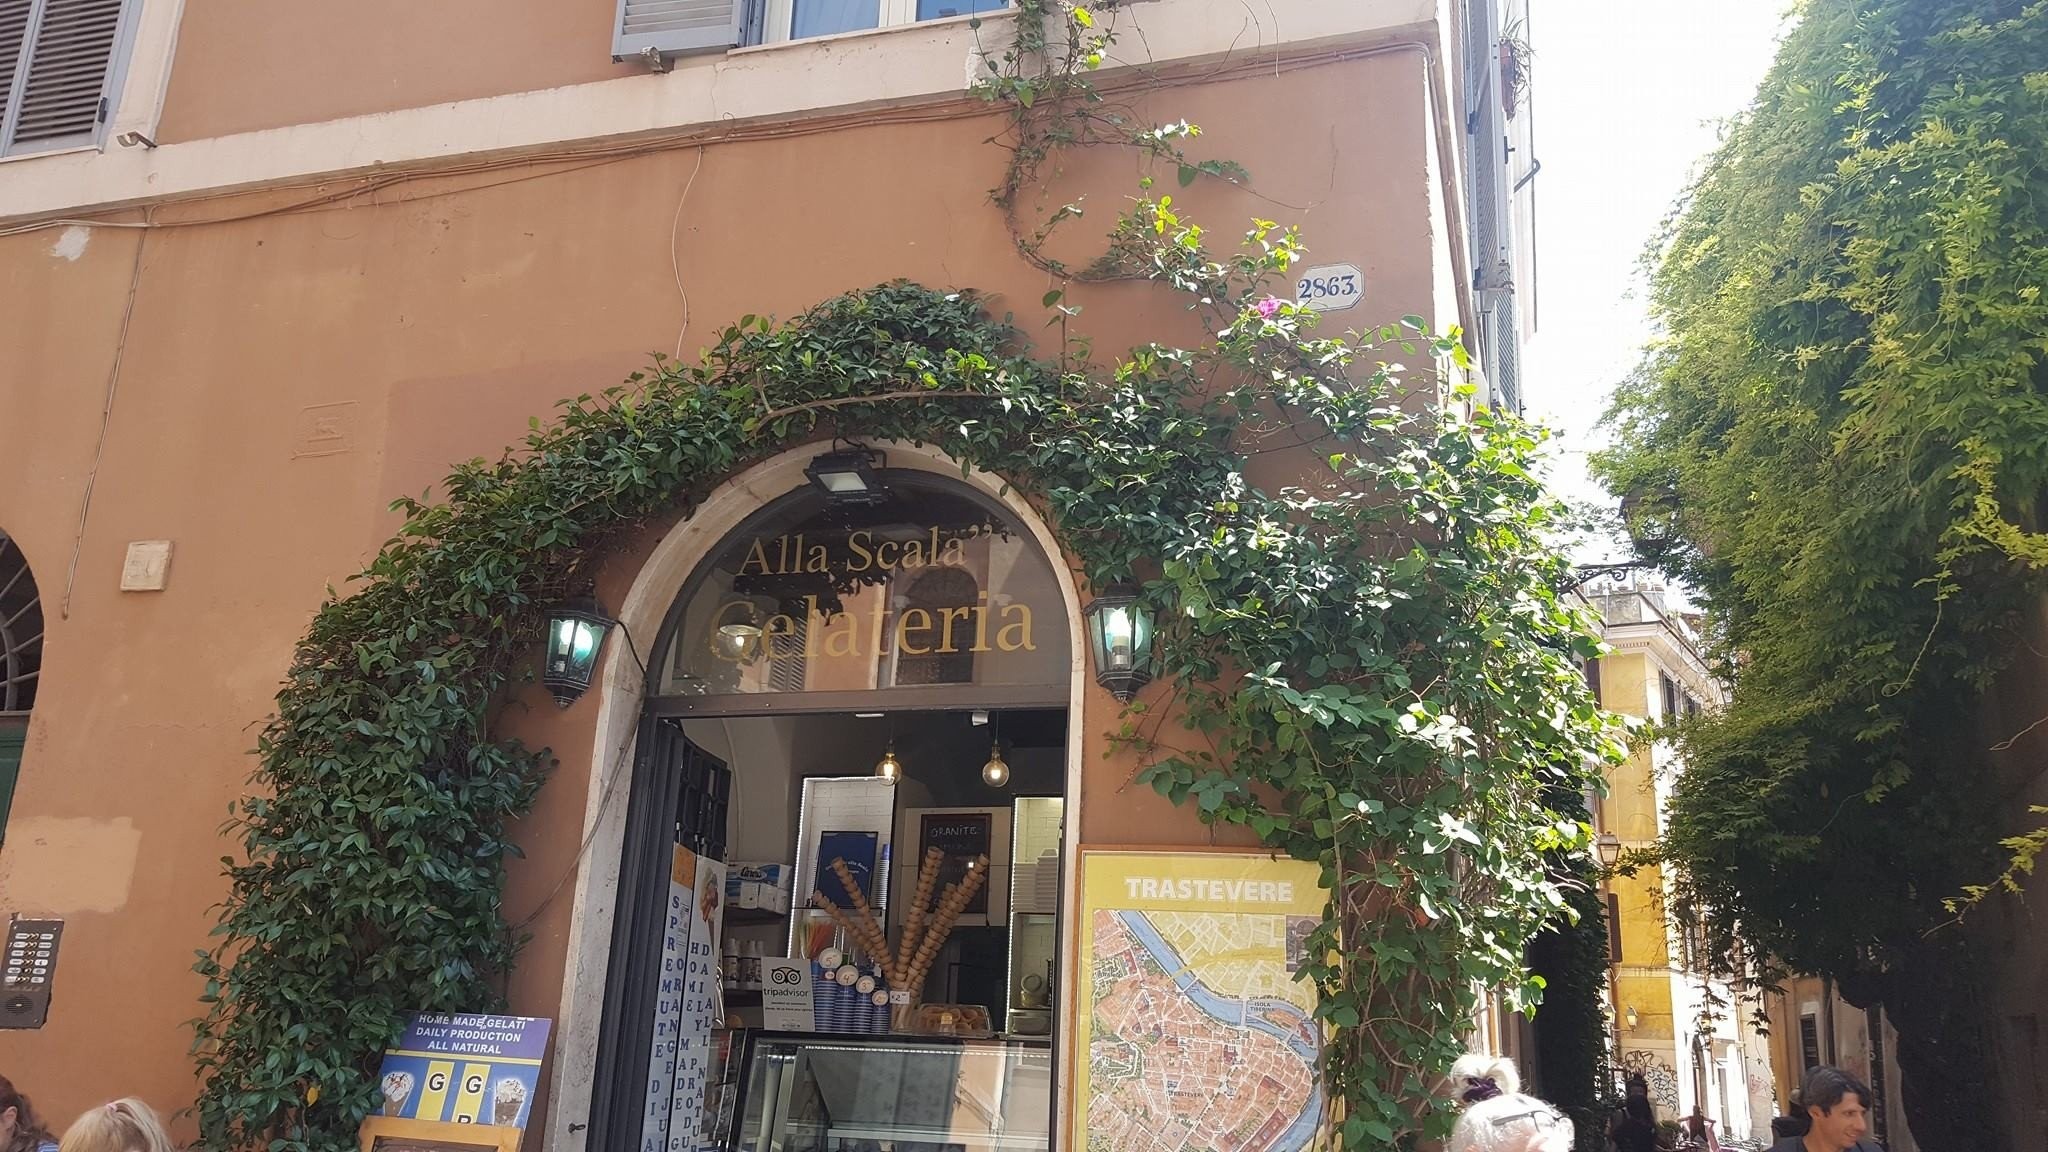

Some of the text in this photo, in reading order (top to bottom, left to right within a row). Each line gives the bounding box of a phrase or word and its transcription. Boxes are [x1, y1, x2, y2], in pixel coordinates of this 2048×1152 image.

[736, 533, 829, 577] Alla
[710, 590, 1036, 662] Gelateria
[1125, 878, 1294, 903] TRASTEVERE
[763, 987, 809, 998] tripadvisor
[418, 1014, 526, 1030] HOME MADE GELATI
[416, 1027, 521, 1042] DAILY PRODUCTION
[427, 1040, 502, 1054] ALL NATURAL
[429, 1072, 446, 1092] G
[465, 1075, 482, 1094] G
